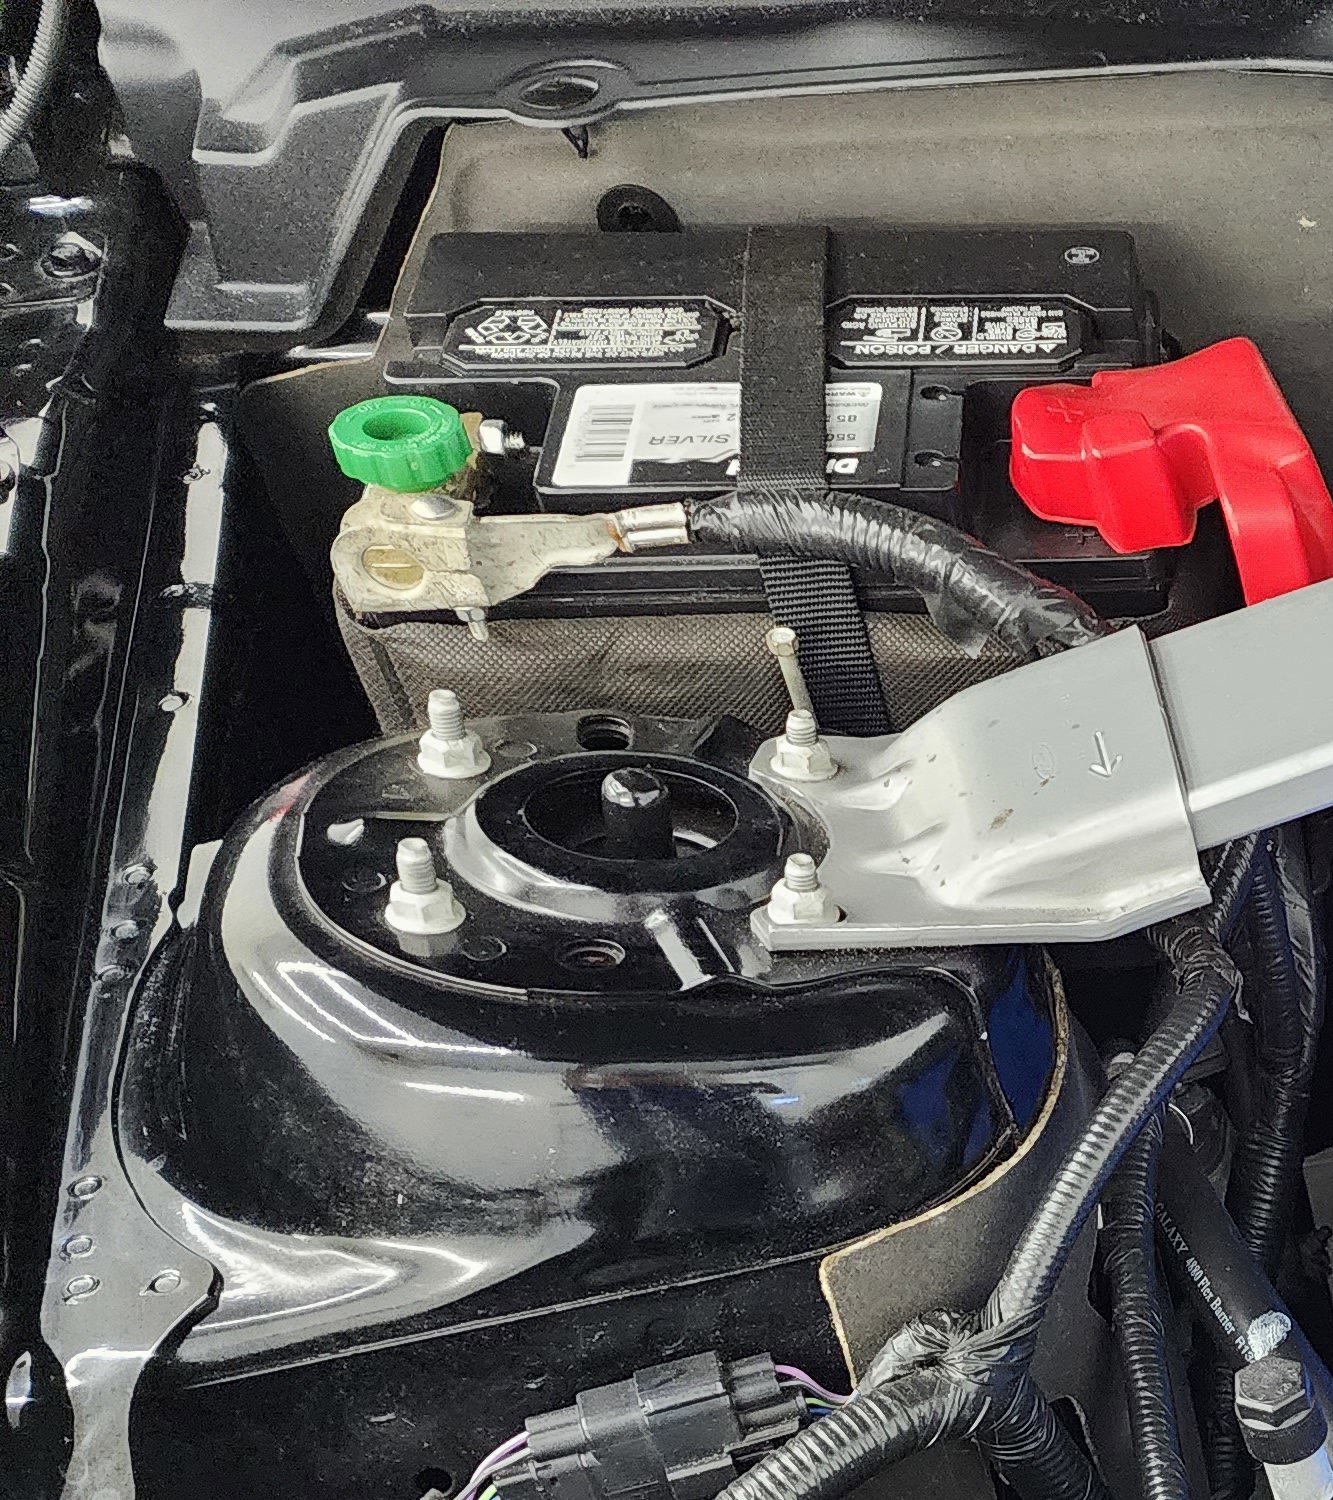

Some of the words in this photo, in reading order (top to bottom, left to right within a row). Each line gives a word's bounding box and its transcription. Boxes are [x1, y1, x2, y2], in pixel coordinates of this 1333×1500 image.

[854, 343, 931, 355] POISON
[953, 343, 1037, 355] DANGER
[649, 433, 731, 446] SILVER
[1154, 1202, 1190, 1254] GALAXY
[1185, 1257, 1204, 1281] 4880
[1197, 1275, 1215, 1303] Flex
[1209, 1296, 1236, 1335] Barrier
[1234, 1336, 1256, 1363] R13
